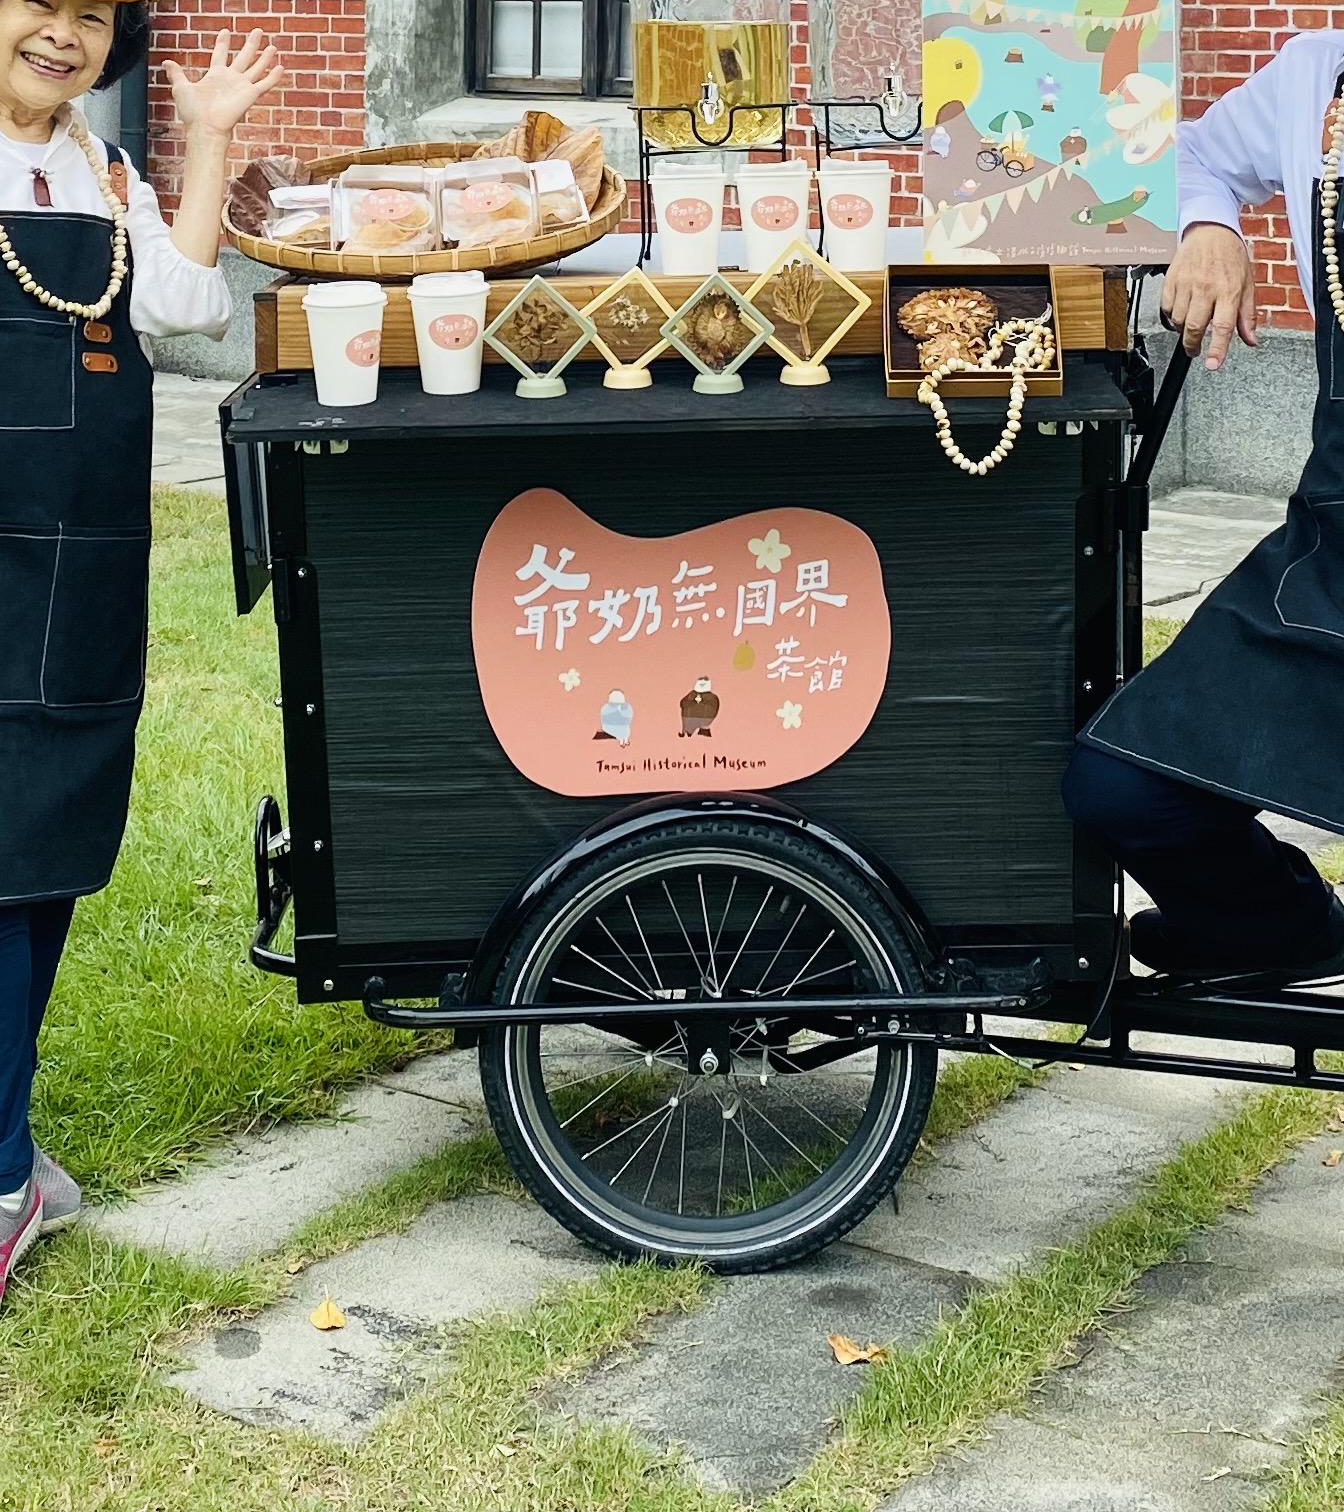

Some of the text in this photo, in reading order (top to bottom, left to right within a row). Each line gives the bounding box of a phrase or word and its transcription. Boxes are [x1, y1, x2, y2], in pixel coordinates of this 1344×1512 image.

[513, 543, 848, 651] 爺奶無國界
[766, 635, 847, 694] 茶館
[596, 753, 767, 774] Tamsui Historical Museum
